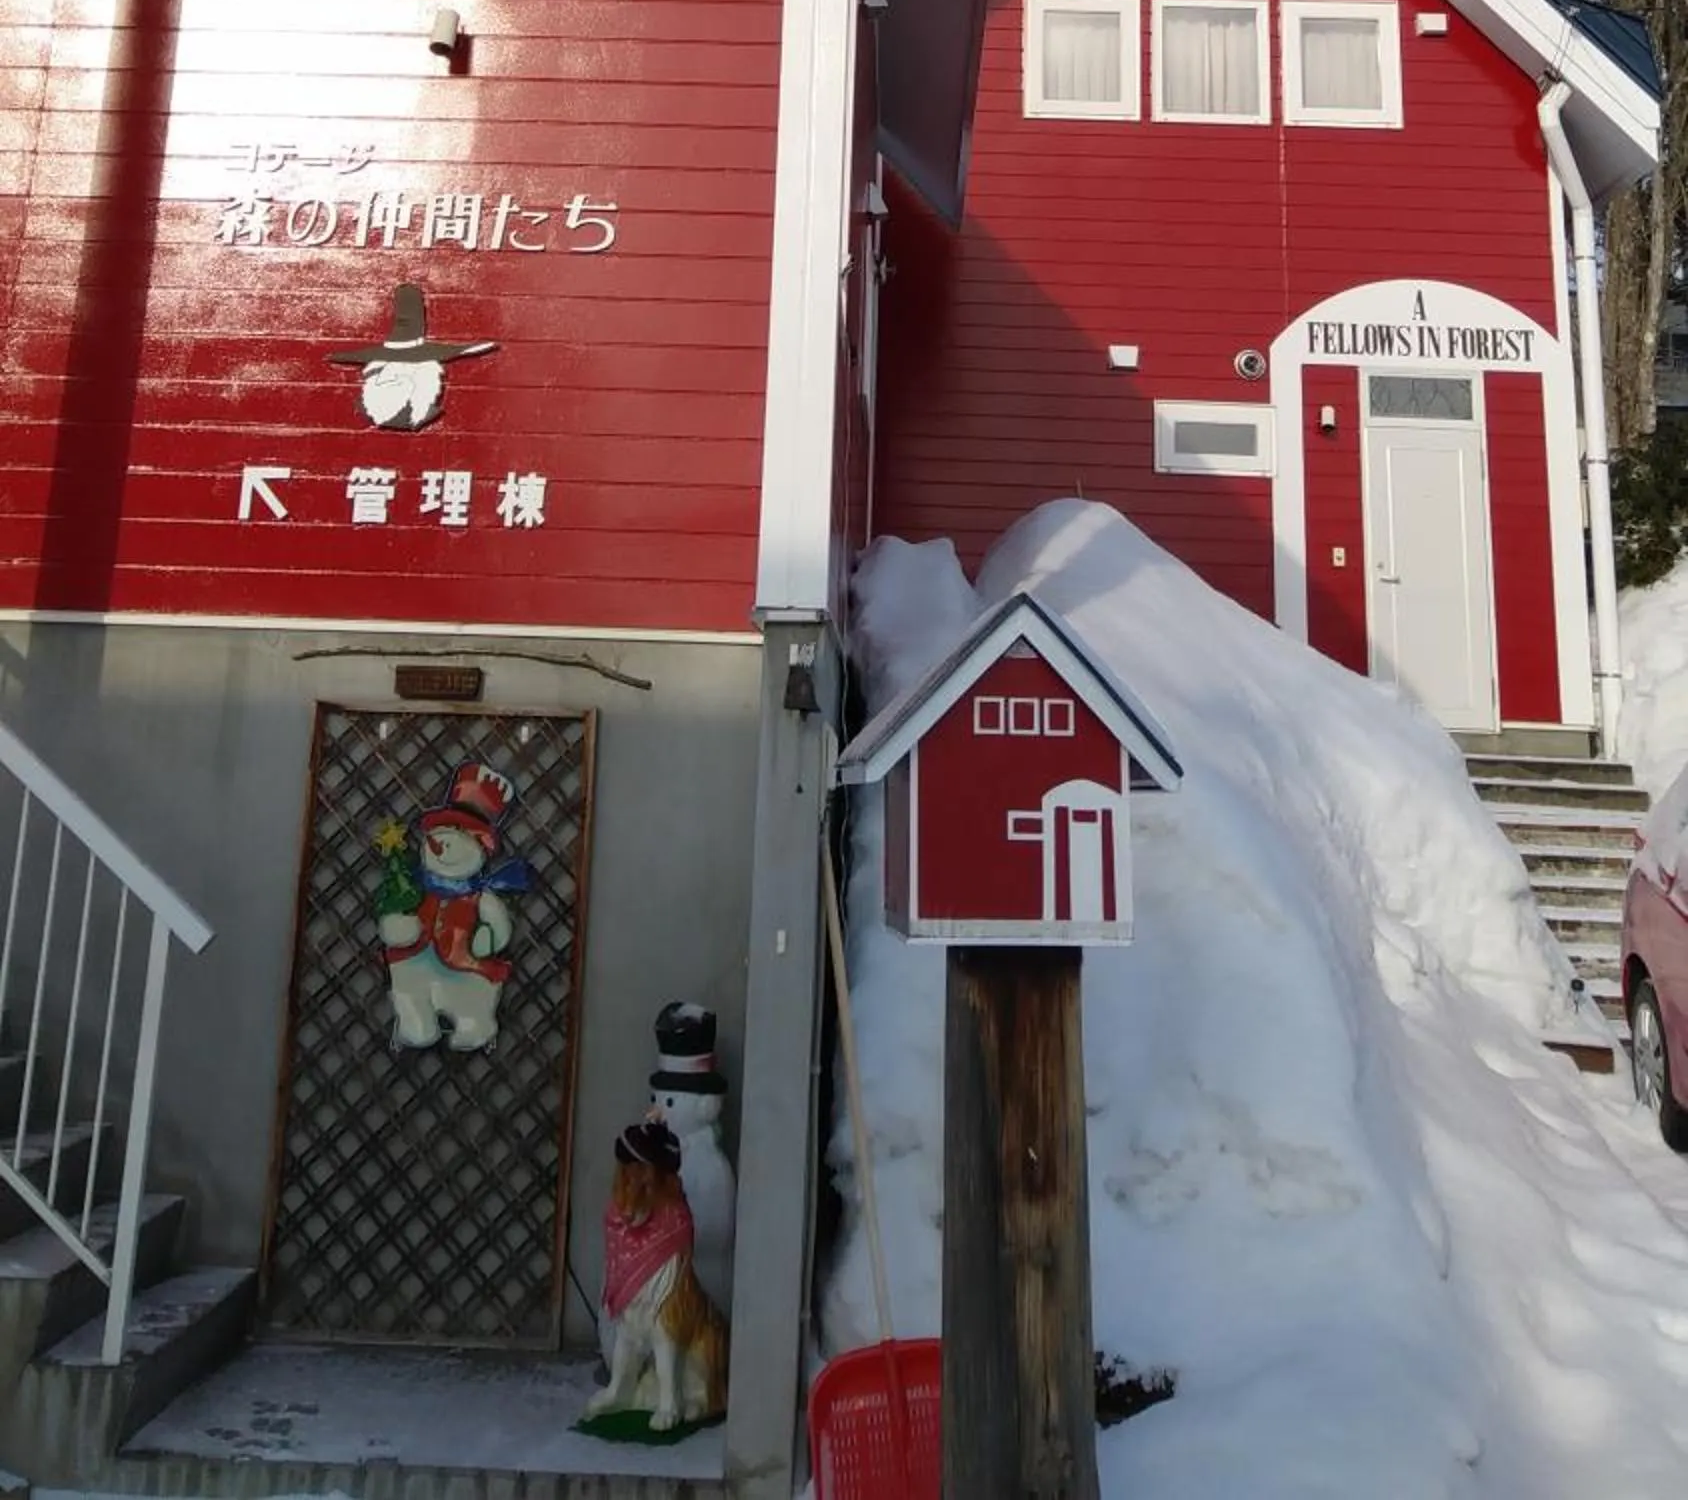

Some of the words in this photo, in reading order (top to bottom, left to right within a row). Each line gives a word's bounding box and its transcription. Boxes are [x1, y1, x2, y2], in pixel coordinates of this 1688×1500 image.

[224, 144, 376, 175] コテージ
[214, 190, 618, 253] 森の仲間たち
[1411, 289, 1427, 321] A
[1307, 321, 1411, 357] FELLOWS
[1418, 325, 1442, 358] IN
[1448, 327, 1535, 362] FOREST
[345, 466, 548, 529] 管理棟
